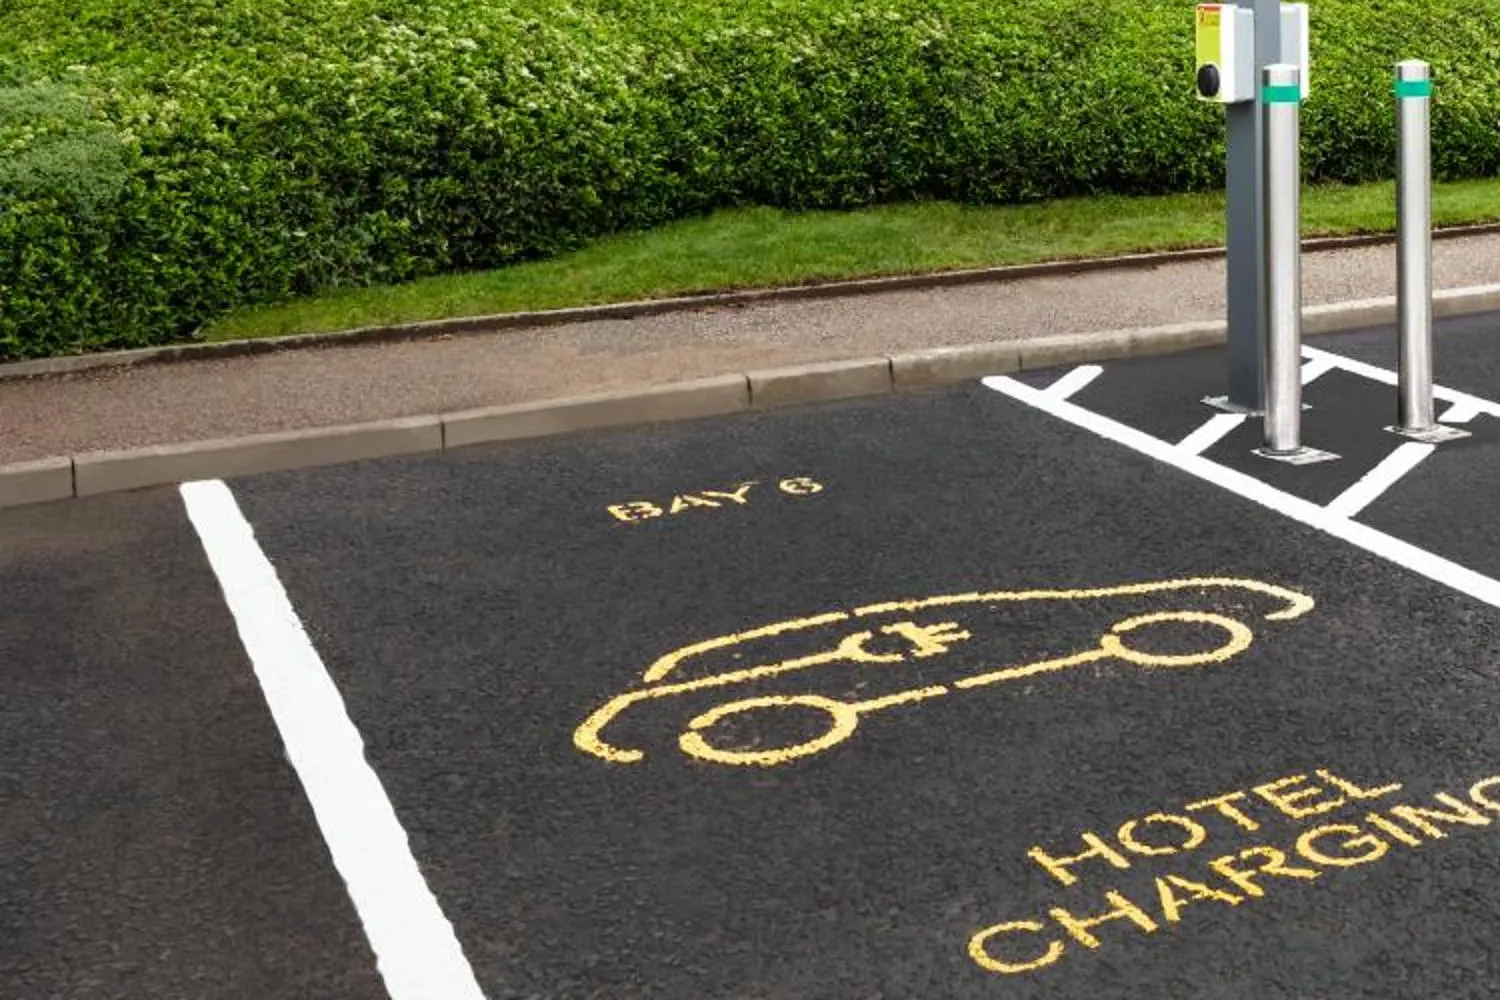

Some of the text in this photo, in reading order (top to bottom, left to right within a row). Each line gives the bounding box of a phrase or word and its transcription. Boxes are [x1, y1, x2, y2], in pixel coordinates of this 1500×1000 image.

[606, 476, 823, 522] BAY 6
[1027, 769, 1402, 887] HOTEL
